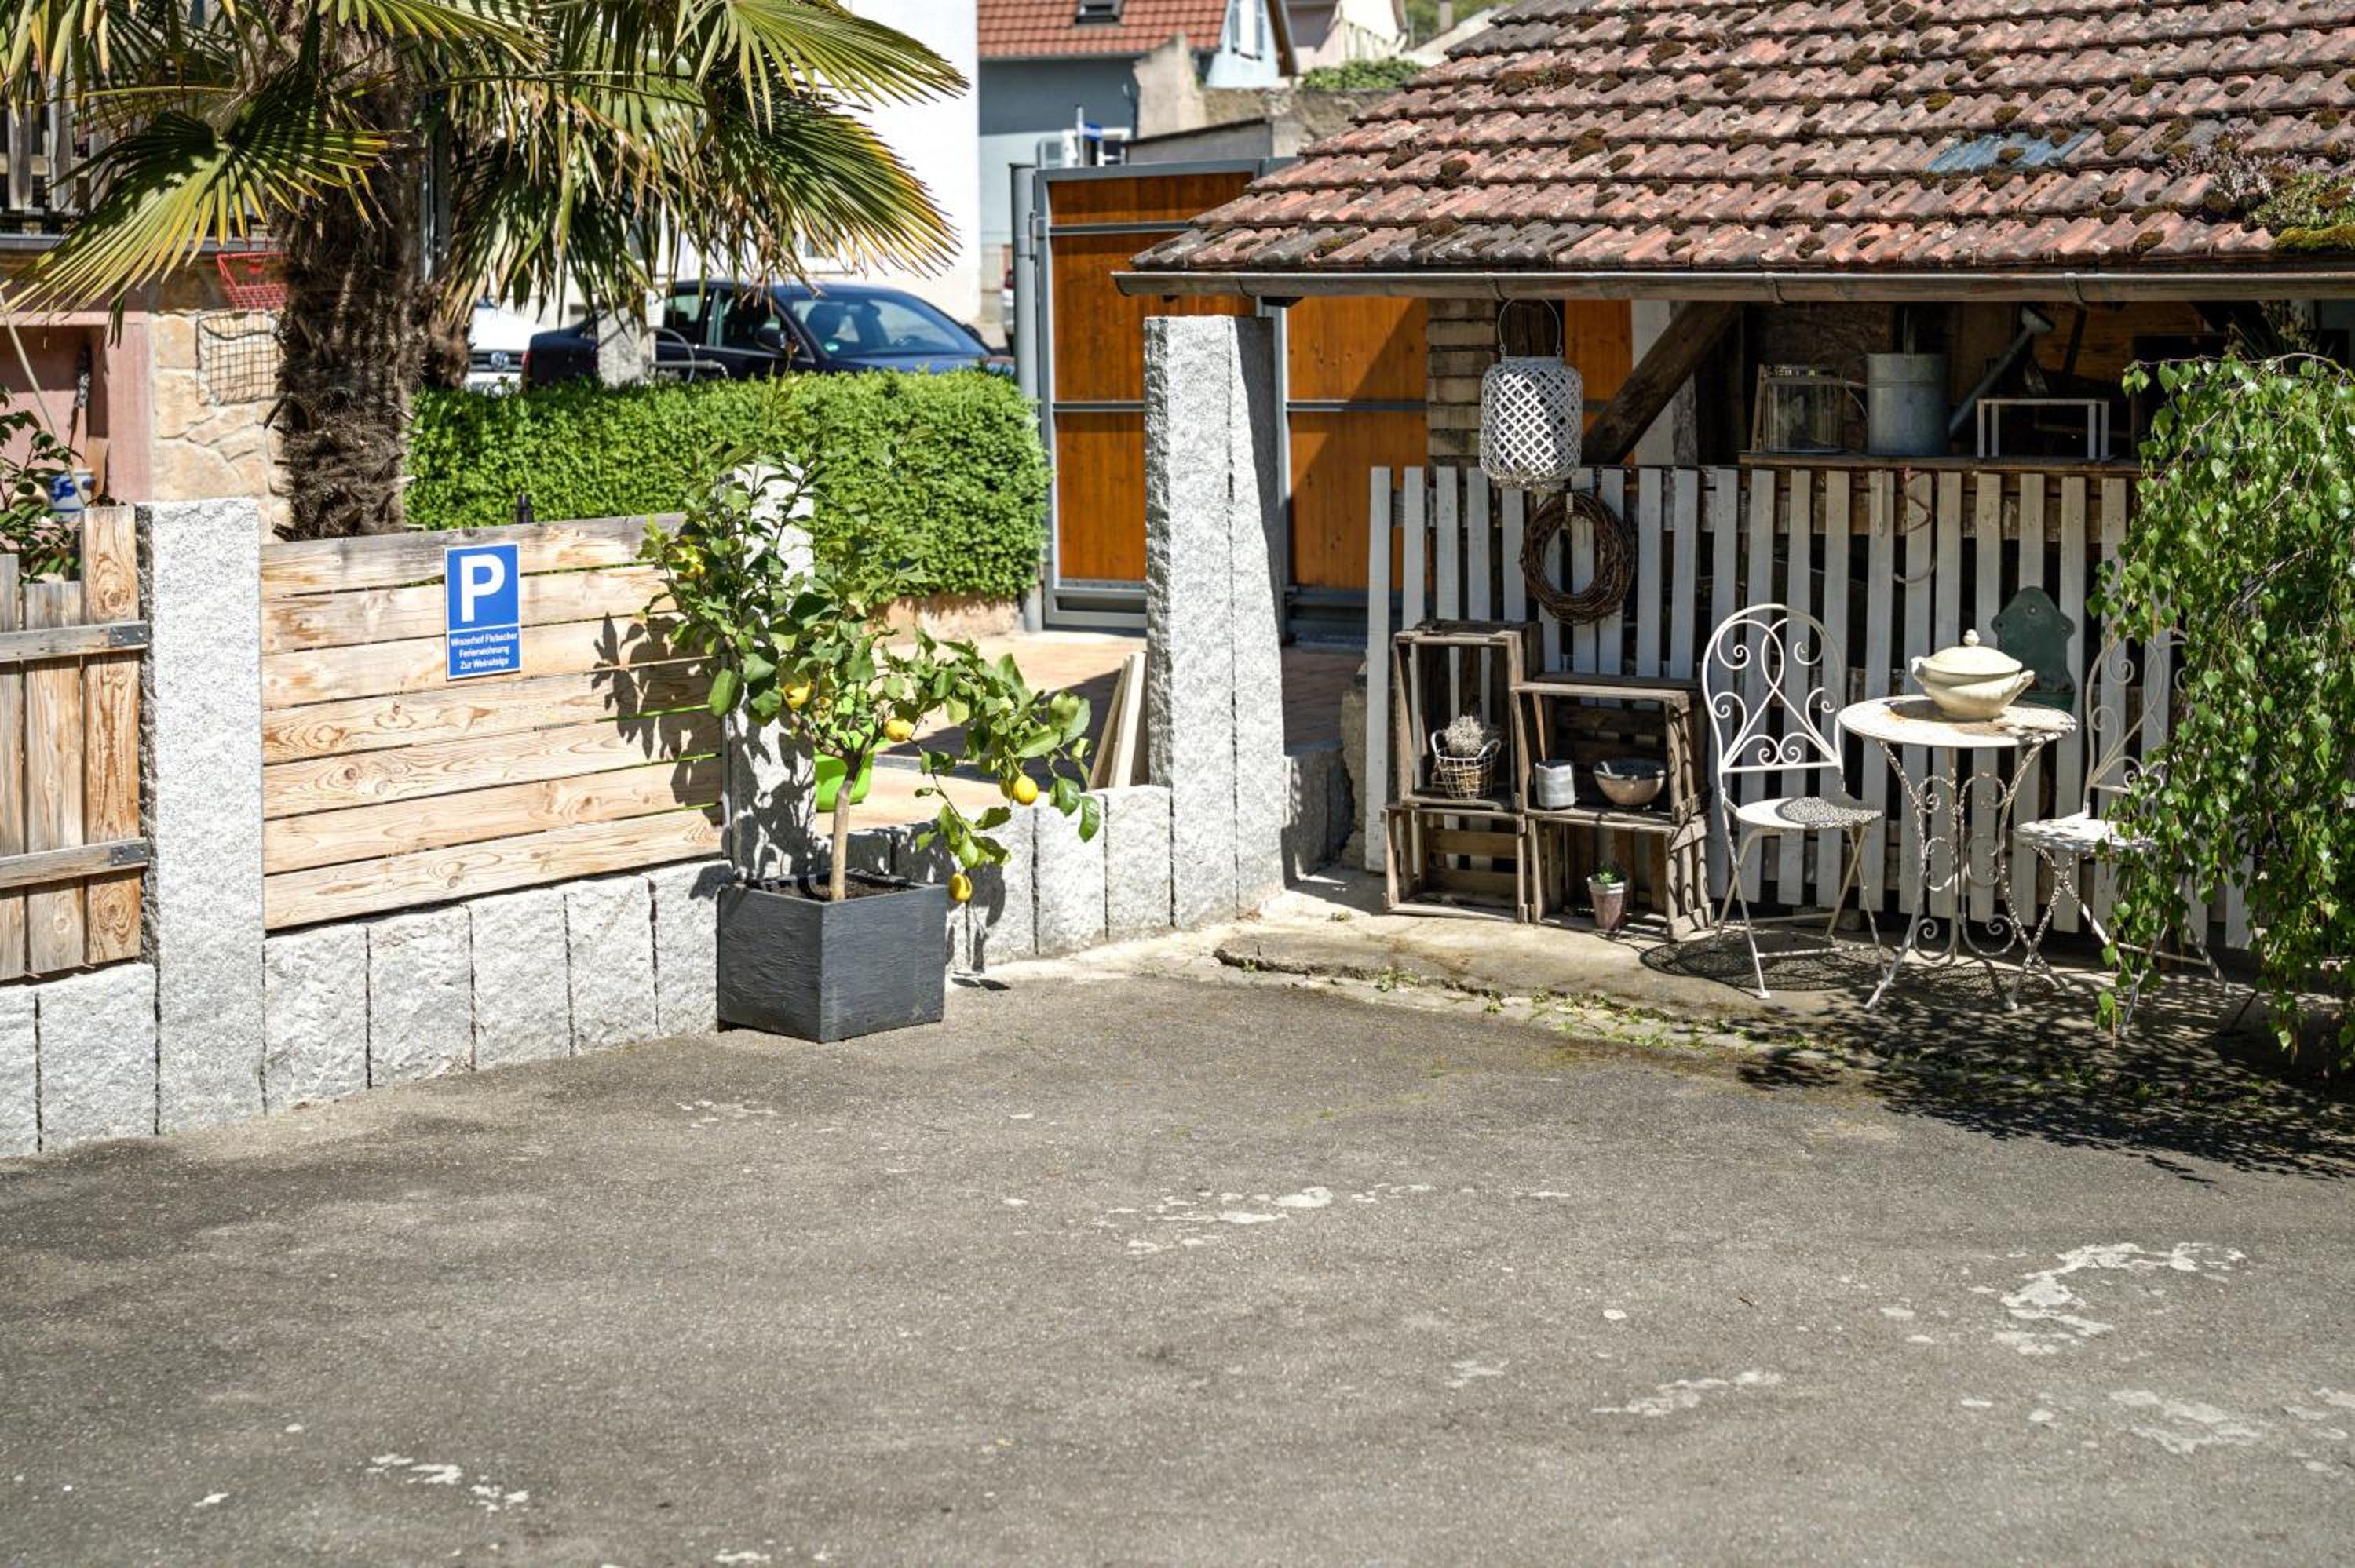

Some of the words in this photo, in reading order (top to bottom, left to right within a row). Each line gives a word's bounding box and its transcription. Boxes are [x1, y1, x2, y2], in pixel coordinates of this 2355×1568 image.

[461, 553, 505, 622] P
[459, 645, 509, 658] Ferienwohnung
[460, 660, 473, 670] Zur
